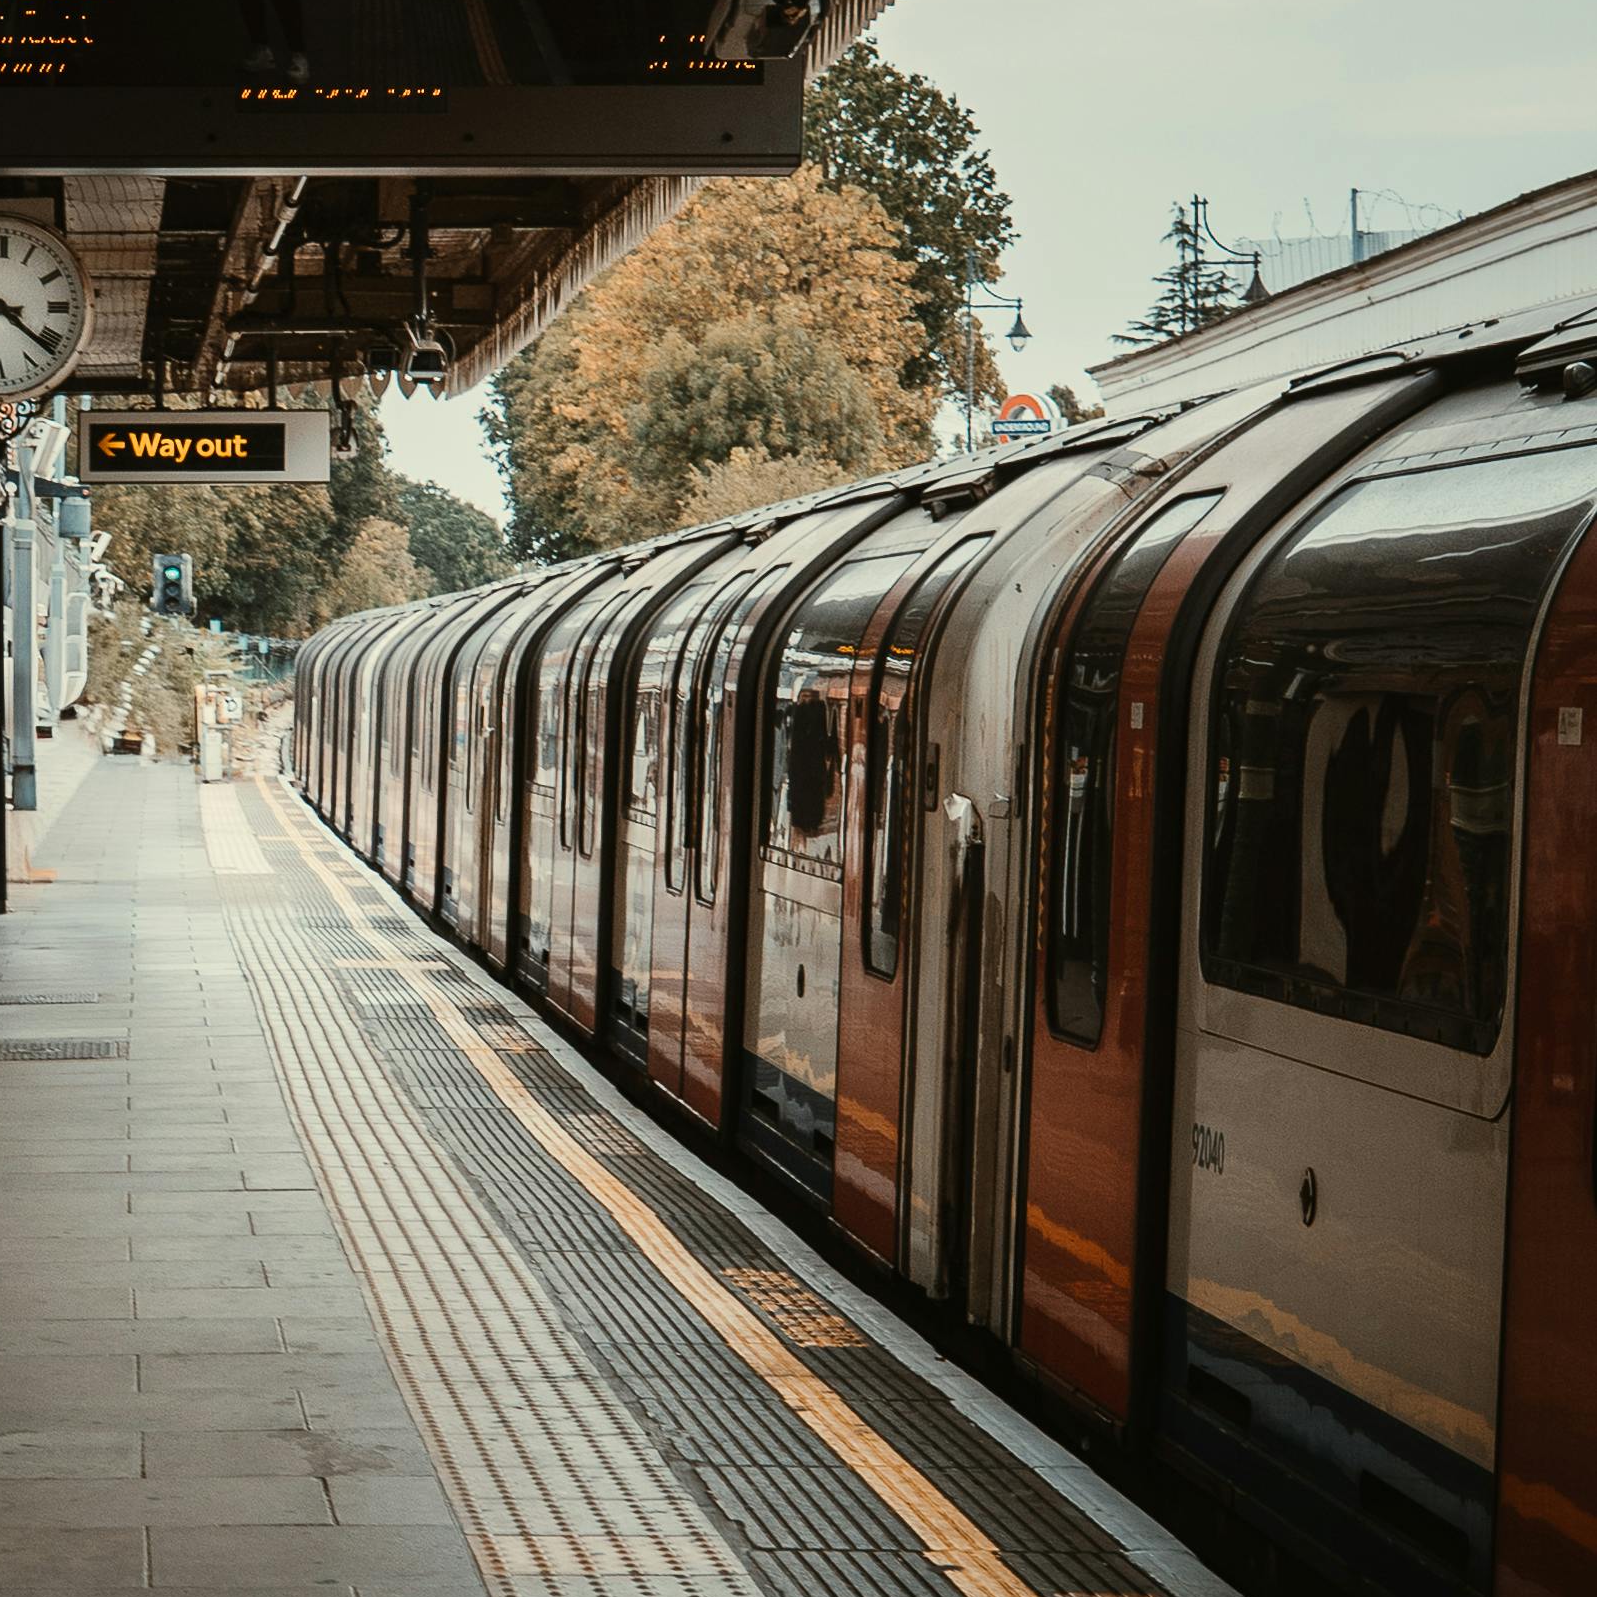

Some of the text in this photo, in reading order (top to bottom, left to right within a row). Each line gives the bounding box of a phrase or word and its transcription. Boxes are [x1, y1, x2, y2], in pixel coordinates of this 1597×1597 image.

[20, 244, 37, 267] I
[38, 268, 63, 285] II
[47, 301, 70, 314] III
[128, 432, 248, 463] Way out
[1192, 1122, 1225, 1175] 92040
